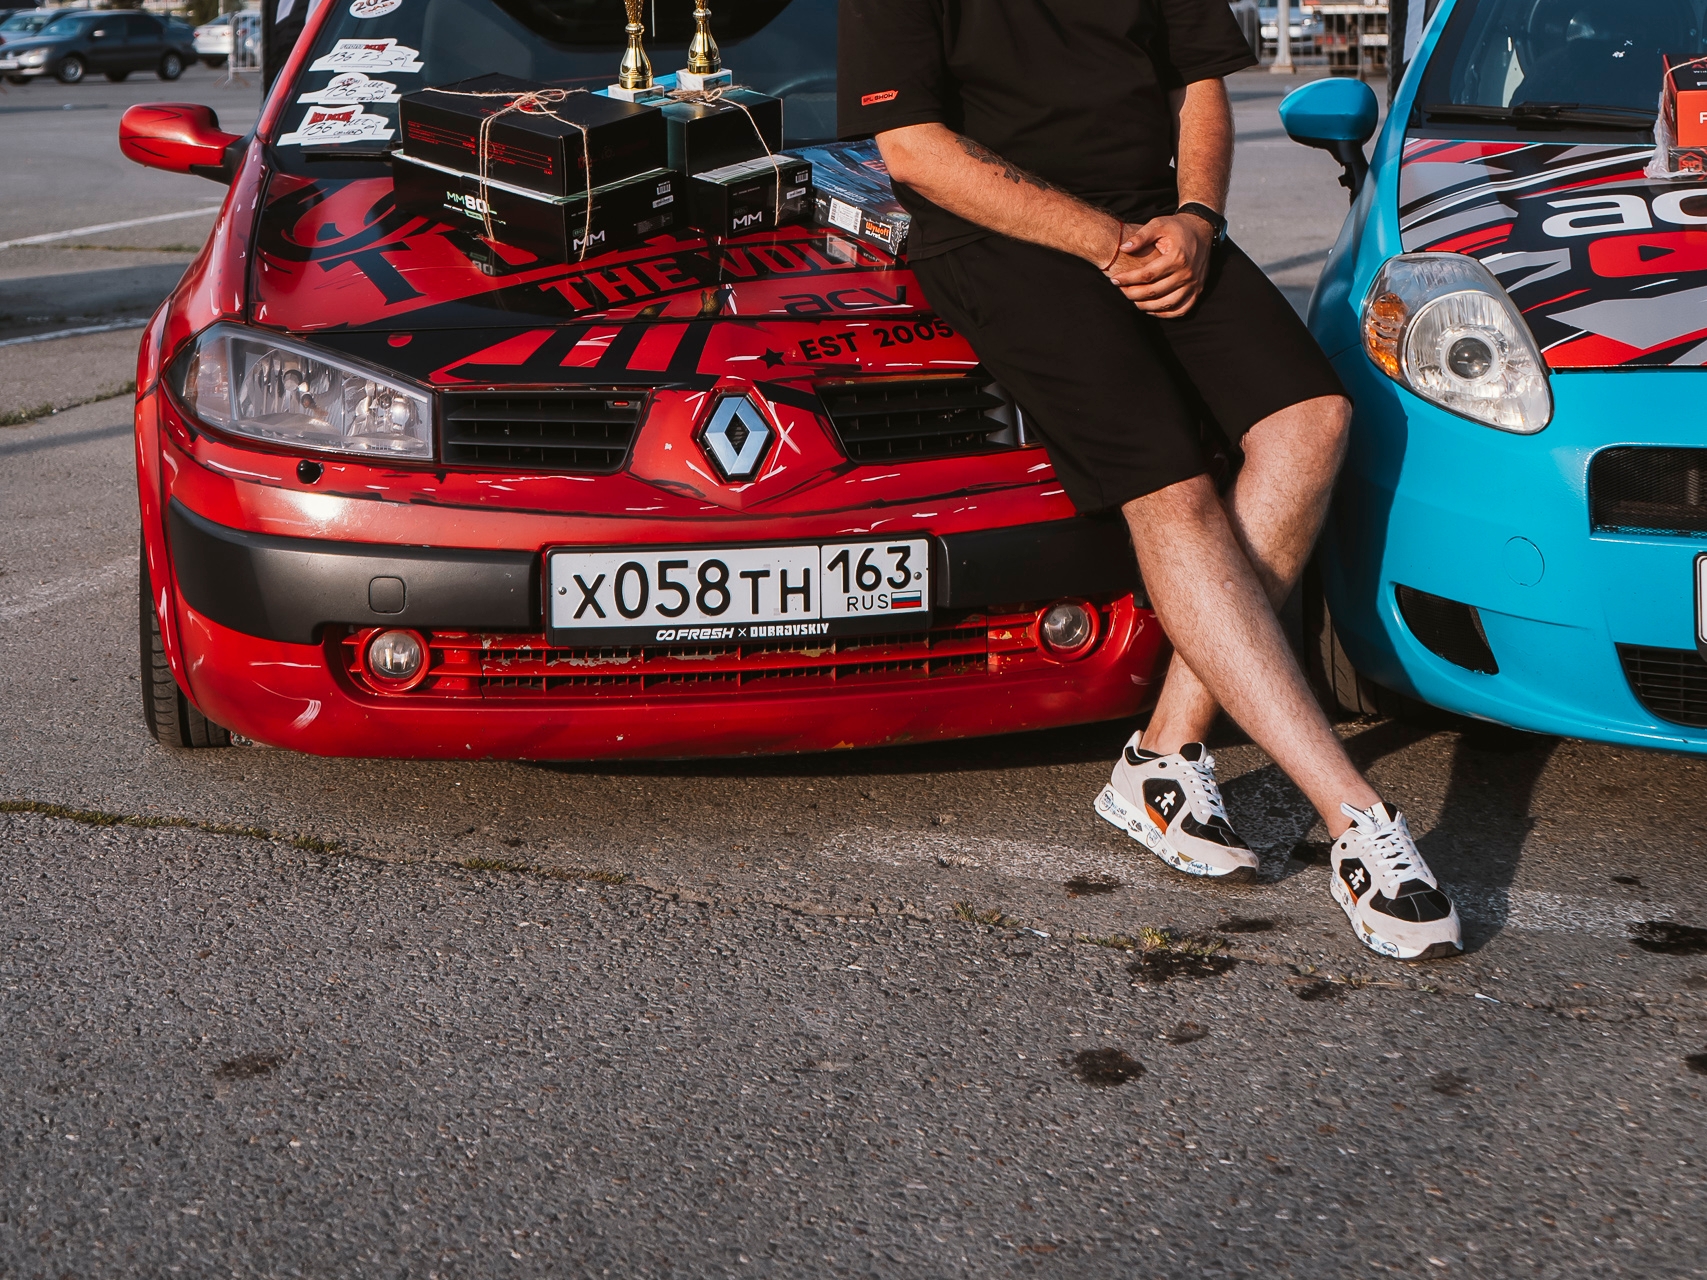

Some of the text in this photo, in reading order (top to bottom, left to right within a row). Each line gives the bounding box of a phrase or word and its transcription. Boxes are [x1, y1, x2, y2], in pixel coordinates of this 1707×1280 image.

[732, 210, 763, 230] MM
[573, 230, 606, 251] MM
[541, 258, 698, 312] THE
[779, 285, 906, 315] acv
[799, 319, 954, 361] EST 2005
[827, 545, 911, 594] 163
[847, 593, 889, 612] RUS
[750, 623, 830, 638] DUBROVSKIY
